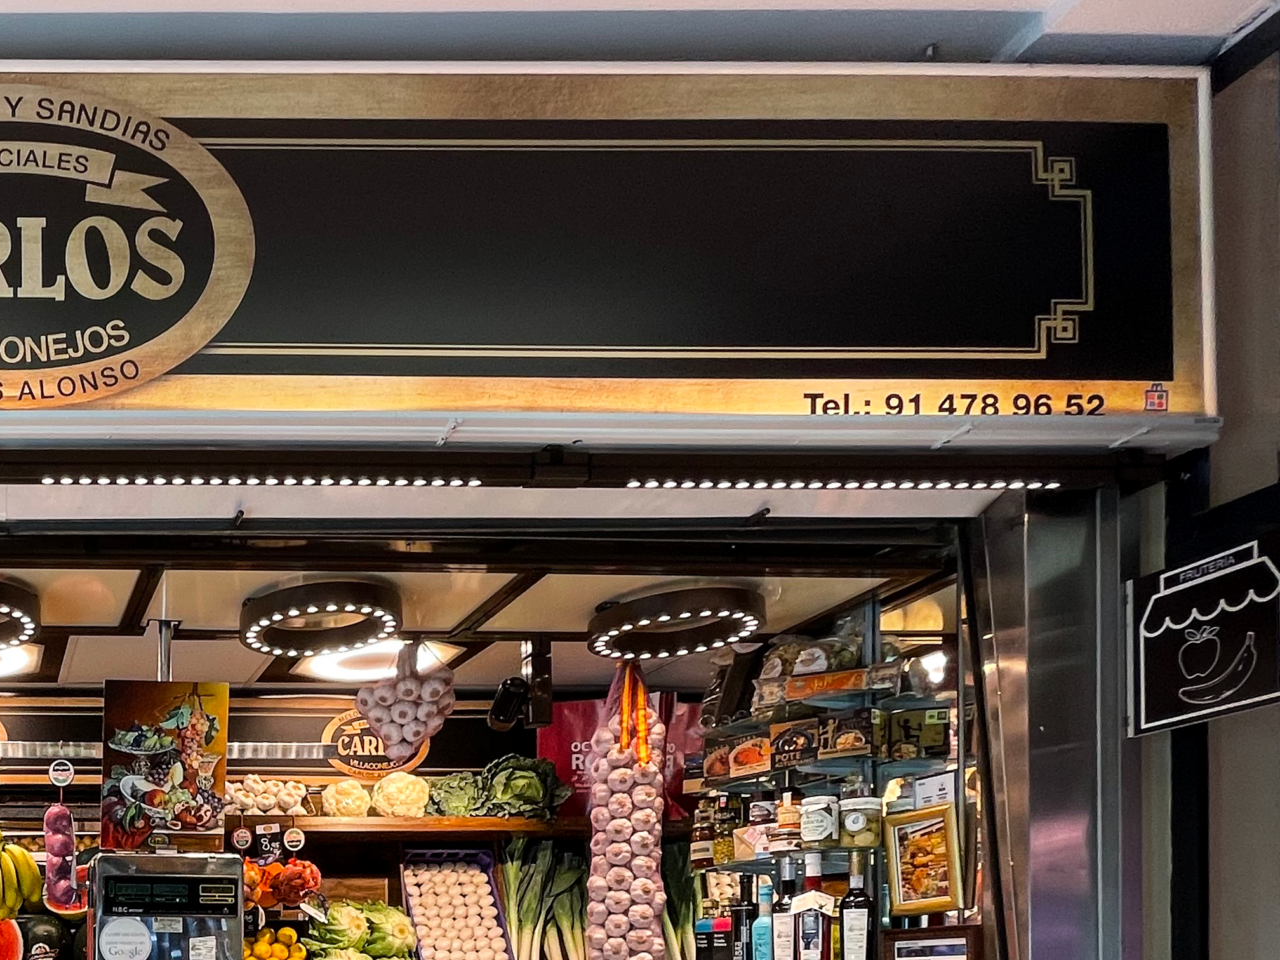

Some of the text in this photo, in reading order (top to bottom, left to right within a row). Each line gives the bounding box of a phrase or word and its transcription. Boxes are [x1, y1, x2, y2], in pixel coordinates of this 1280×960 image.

[3, 95, 25, 119] Y
[35, 97, 172, 153] SANDIAS
[17, 358, 141, 402] ALONSO
[803, 392, 1106, 416] Tel.: 91 478 96 52
[349, 758, 399, 770] VILLACONEJO
[108, 946, 144, 960] Google
